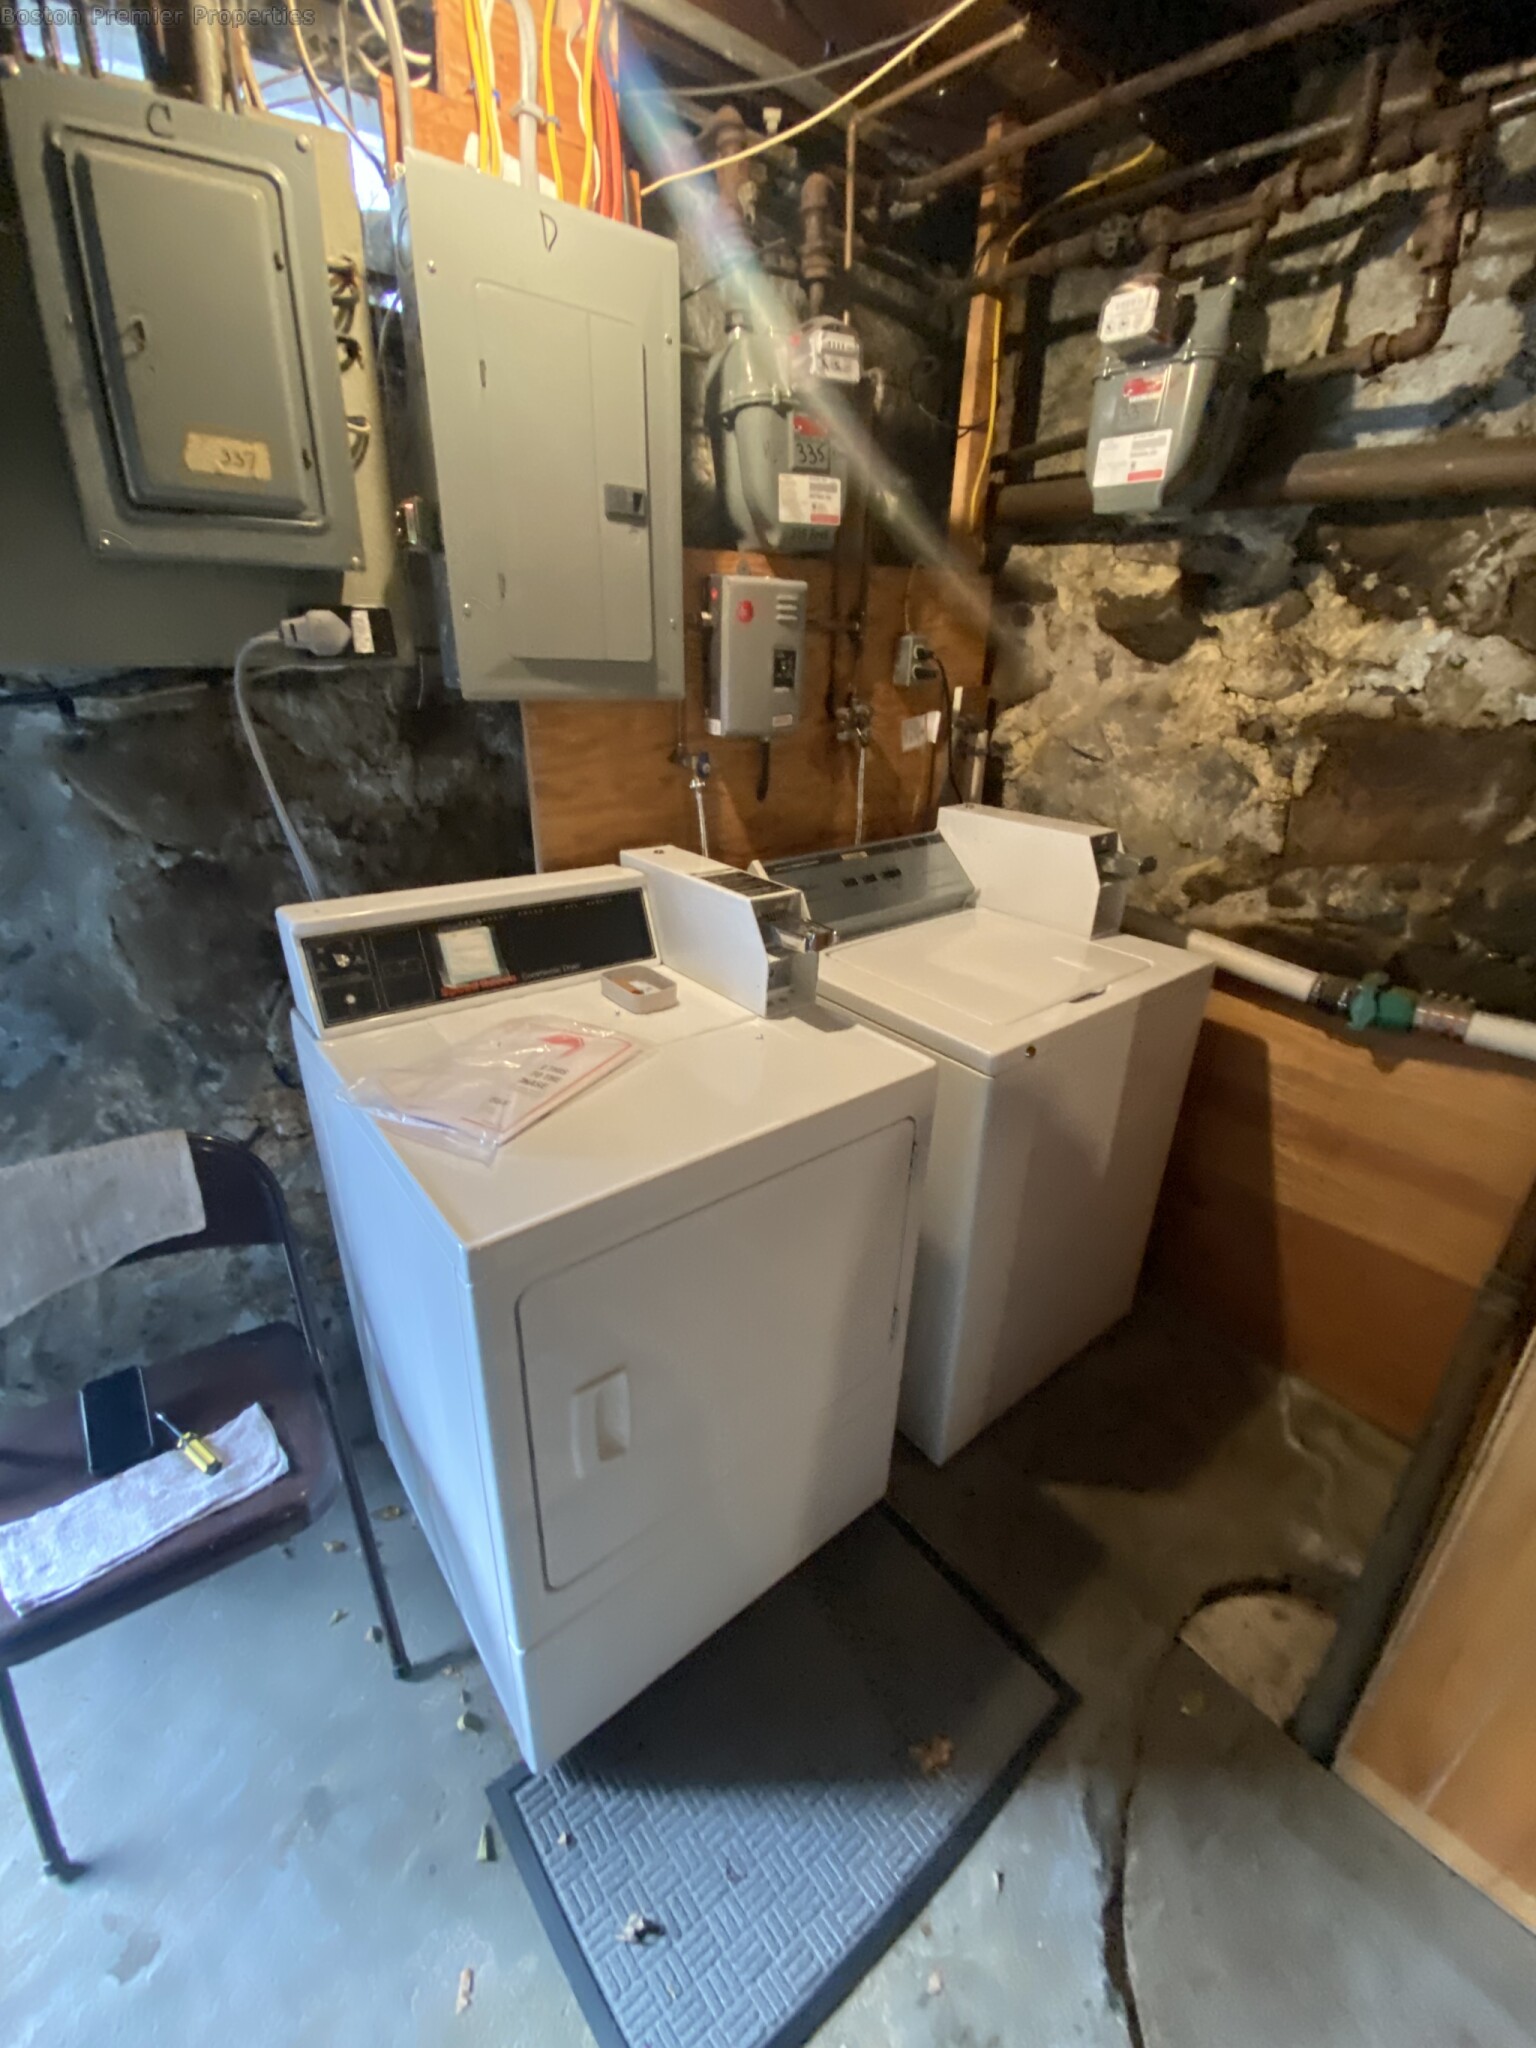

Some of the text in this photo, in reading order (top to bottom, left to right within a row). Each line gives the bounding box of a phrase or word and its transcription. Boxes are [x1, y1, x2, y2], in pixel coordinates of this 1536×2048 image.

[146, 101, 174, 140] C
[539, 209, 558, 253] D
[796, 441, 826, 465] 335
